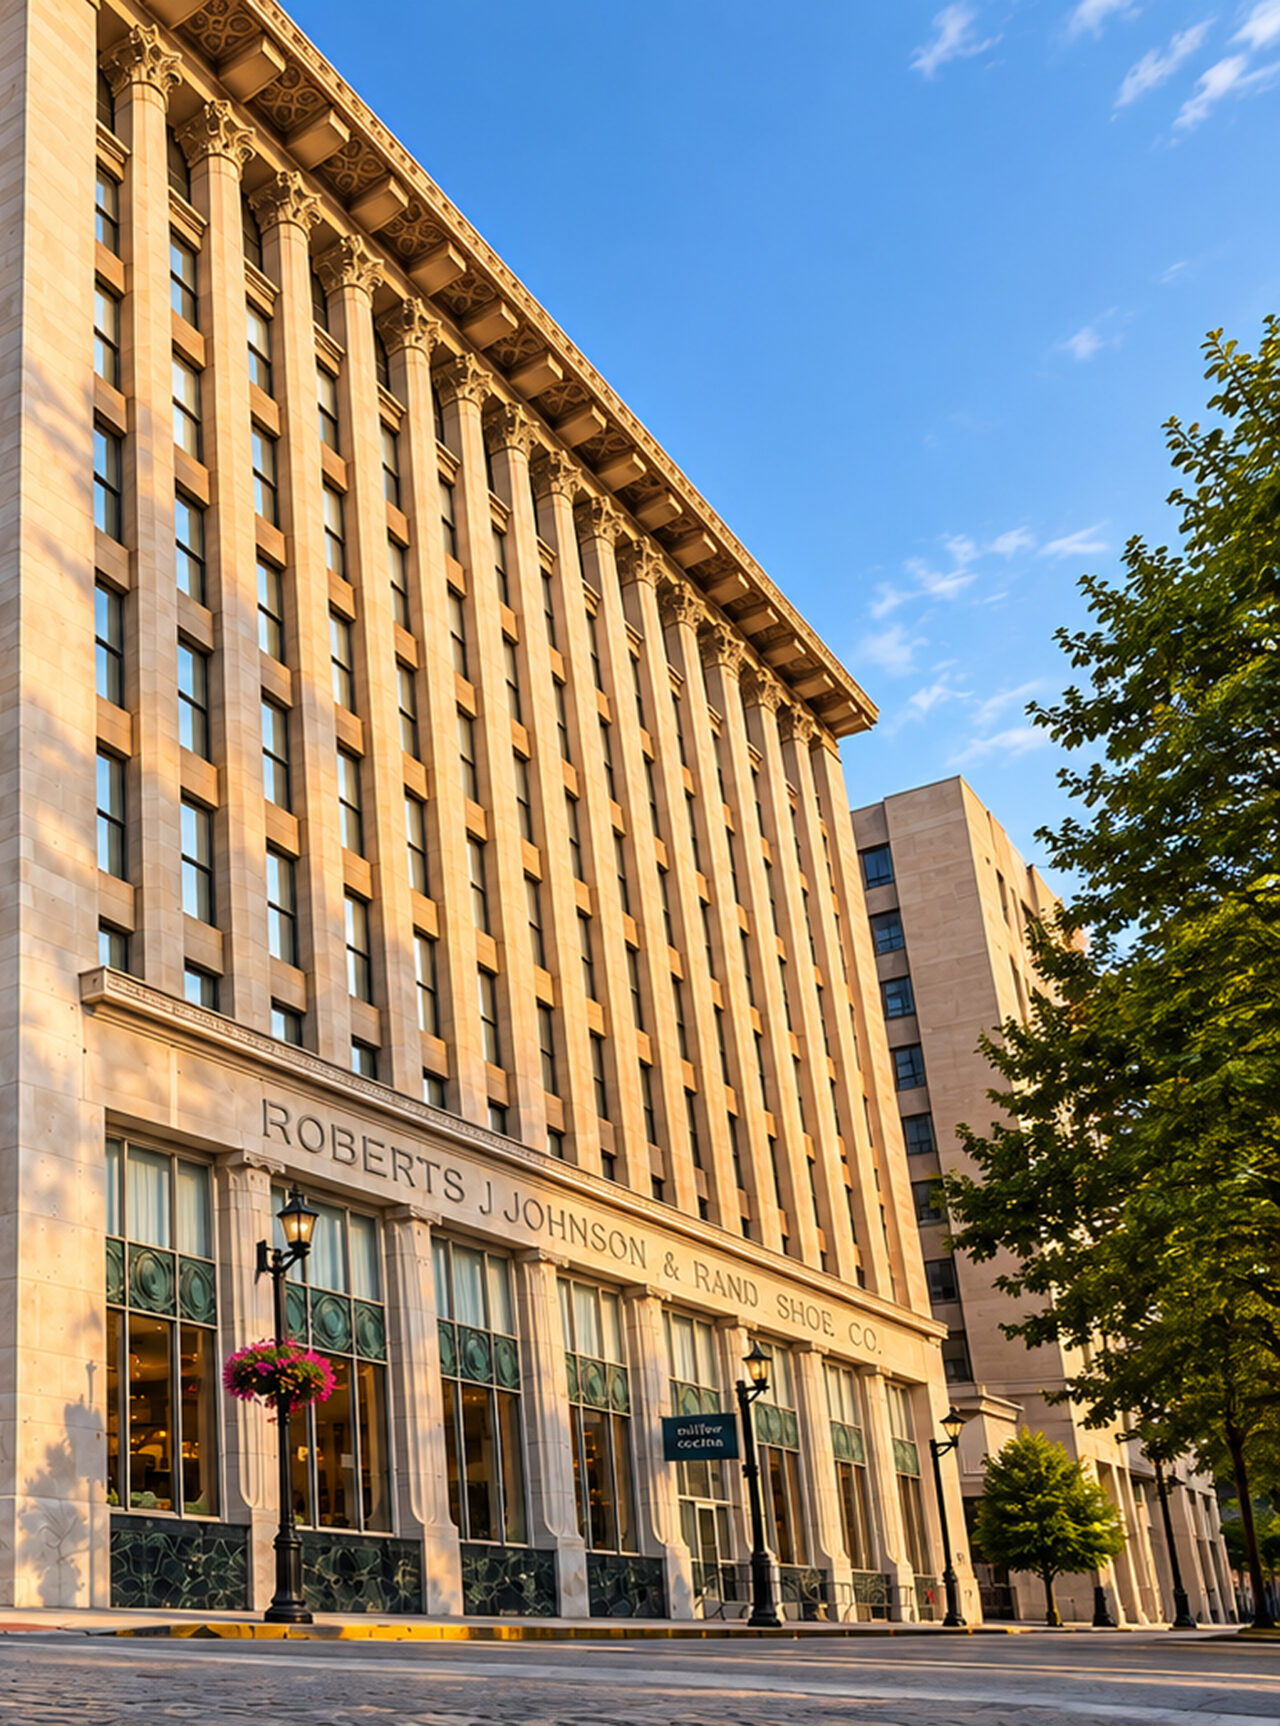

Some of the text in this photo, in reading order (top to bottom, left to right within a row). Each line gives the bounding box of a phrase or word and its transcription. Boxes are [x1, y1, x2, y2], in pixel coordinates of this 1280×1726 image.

[262, 1098, 466, 1204] ROBERTS
[503, 1191, 647, 1270] JOHNSON
[663, 1251, 680, 1281] &
[693, 1260, 759, 1308] RAND
[848, 1322, 882, 1355] CO.
